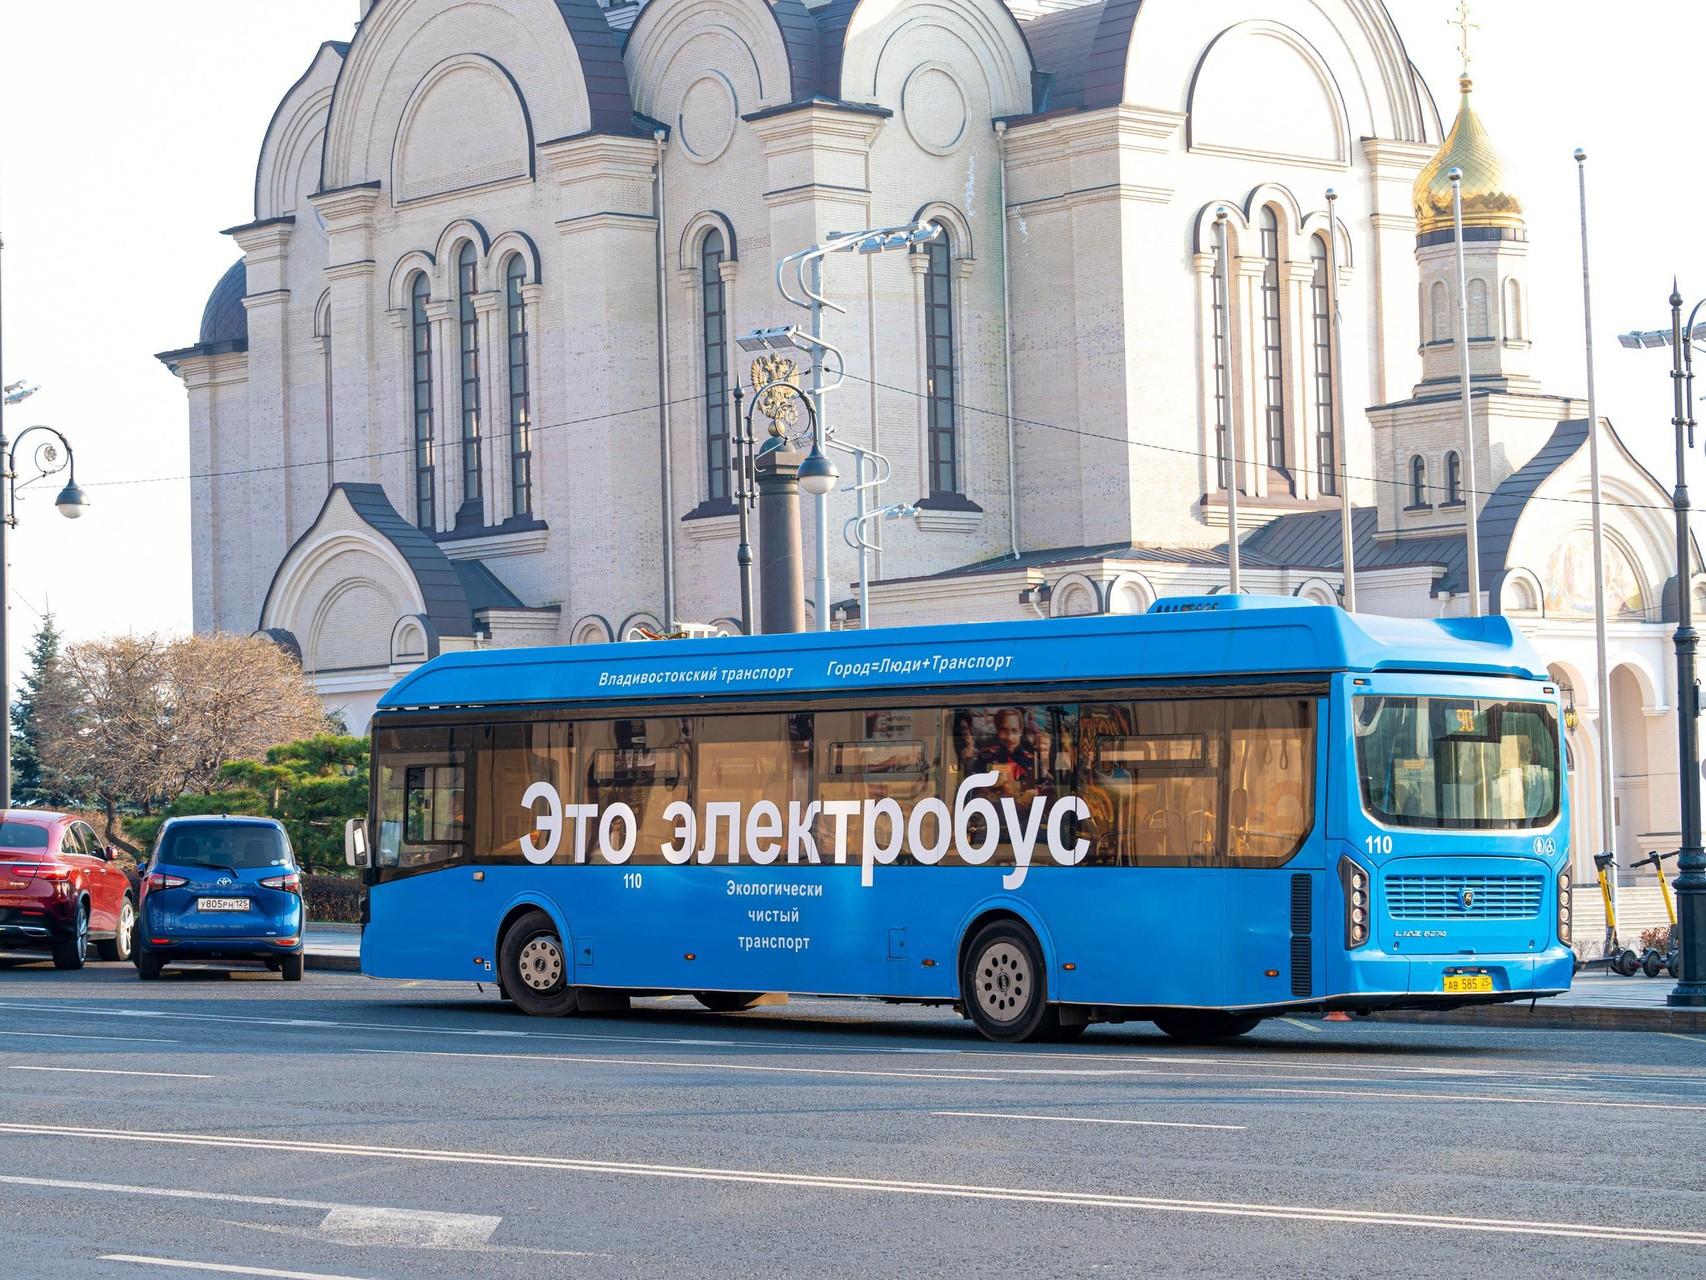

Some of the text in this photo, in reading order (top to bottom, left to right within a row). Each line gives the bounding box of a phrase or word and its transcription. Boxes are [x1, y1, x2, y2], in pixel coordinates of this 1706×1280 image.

[826, 654, 1014, 679] Город=Люди+Транспорт
[598, 665, 795, 688] Владивостокский транспорт
[519, 770, 1091, 890] Это электробус
[1365, 835, 1393, 854] 110
[623, 872, 642, 889] 110
[726, 880, 823, 897] Экологически
[748, 906, 800, 922] чистый
[738, 935, 811, 952] транспорт
[1462, 978, 1477, 990] 585
